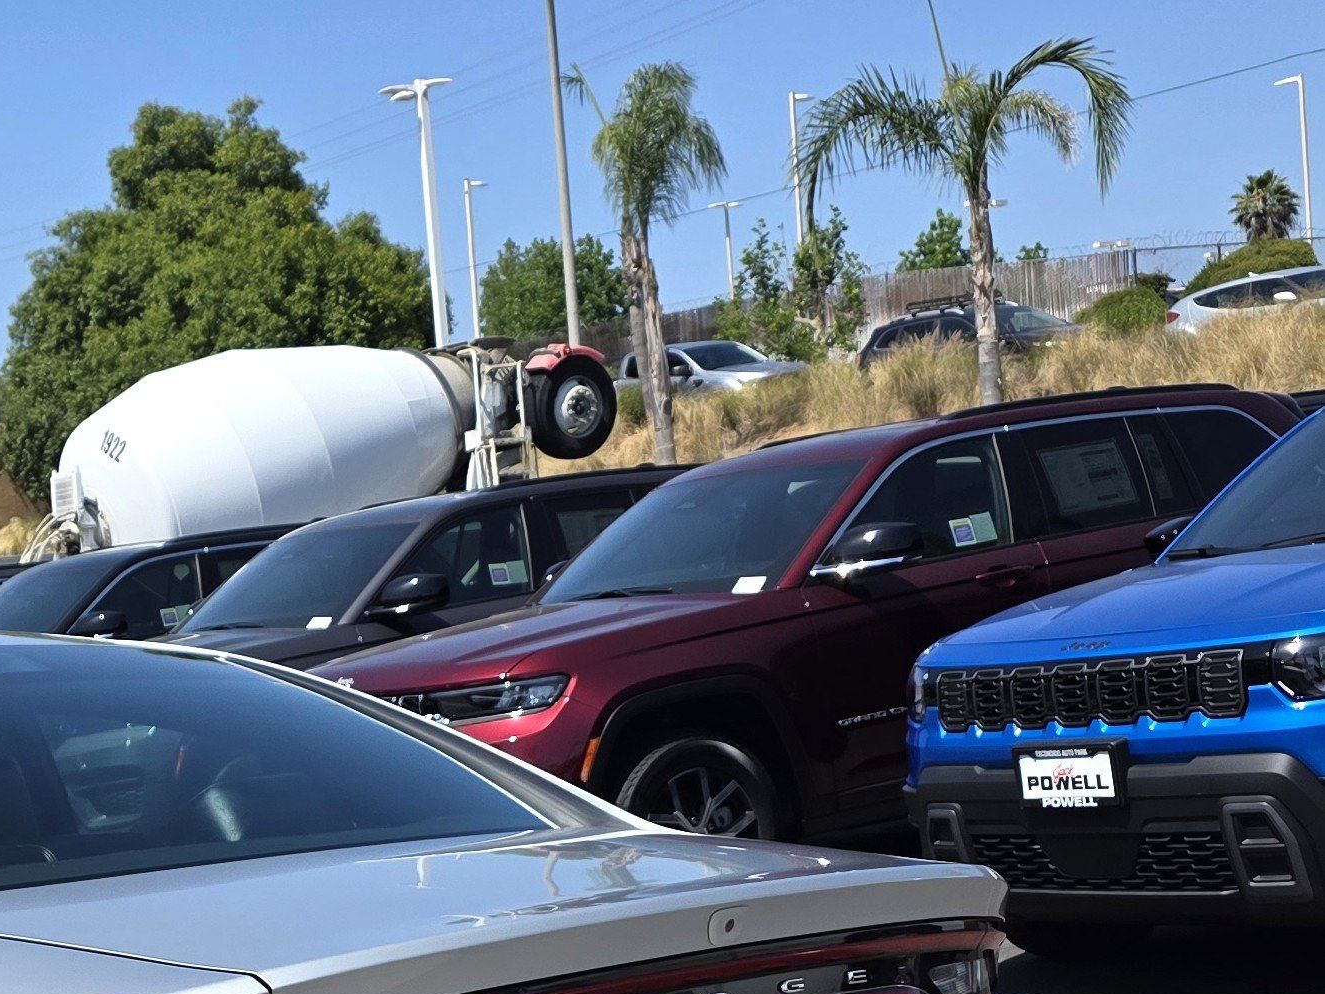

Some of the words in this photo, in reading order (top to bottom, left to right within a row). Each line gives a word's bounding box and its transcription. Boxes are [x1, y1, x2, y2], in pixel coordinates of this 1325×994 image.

[100, 430, 127, 462] 1922
[1026, 773, 1110, 791] POWELL
[1041, 796, 1099, 808] POWELL
